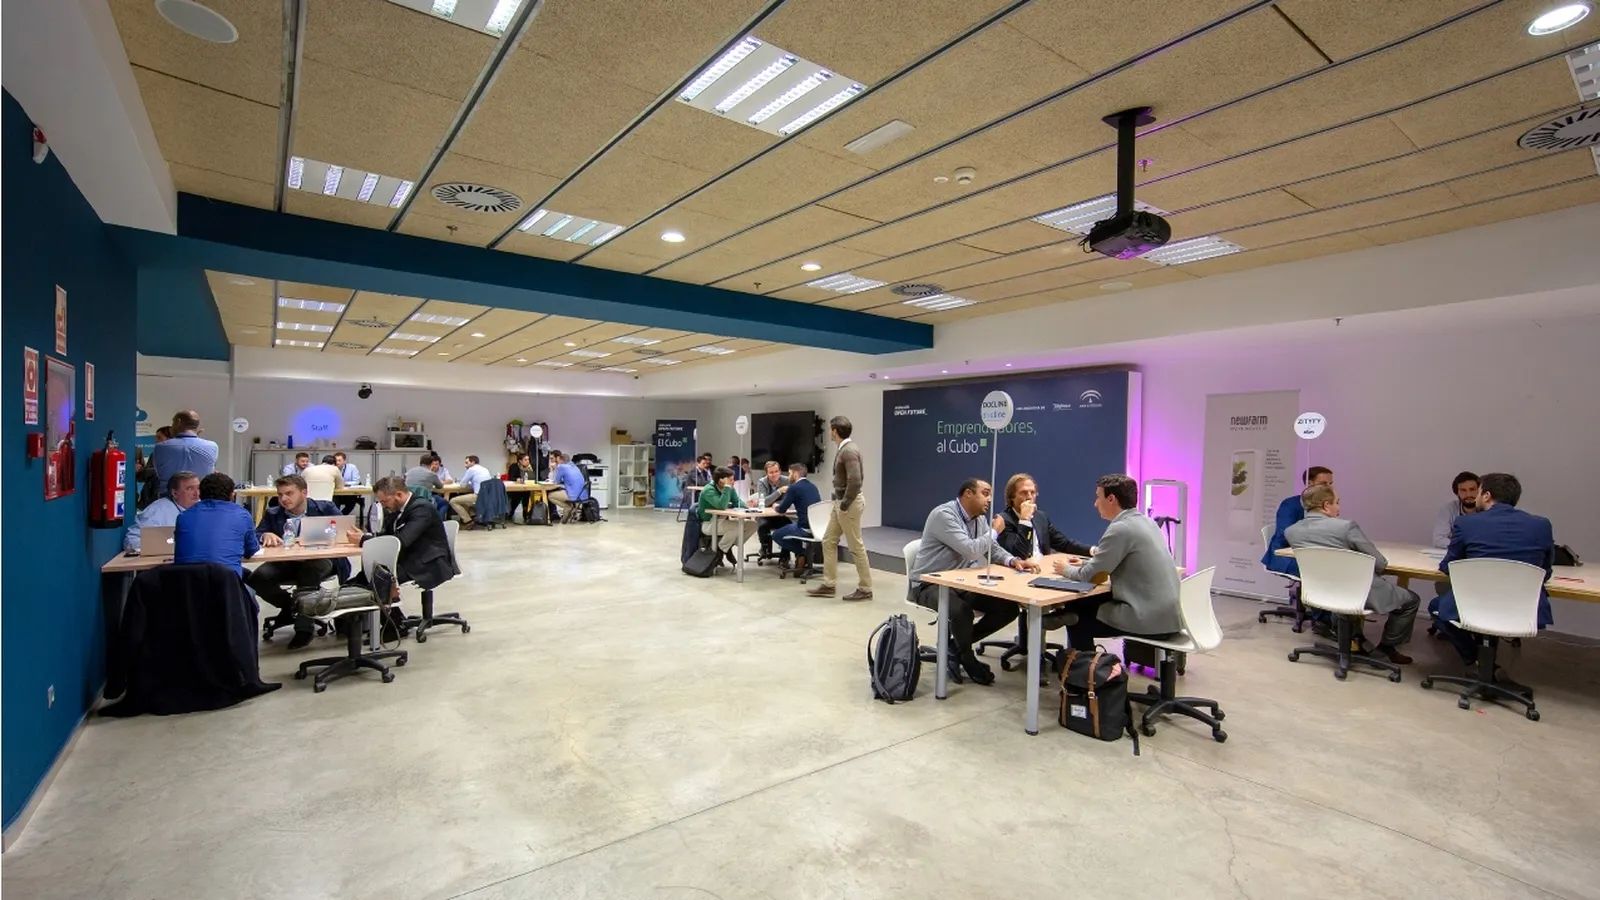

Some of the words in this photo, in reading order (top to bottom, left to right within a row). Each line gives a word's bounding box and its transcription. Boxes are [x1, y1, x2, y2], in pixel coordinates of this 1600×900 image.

[937, 420, 1037, 437] Emprendores,
[658, 438, 664, 447] El
[665, 438, 682, 447] Cubo
[936, 438, 946, 453] al
[949, 439, 979, 453] Cubo
